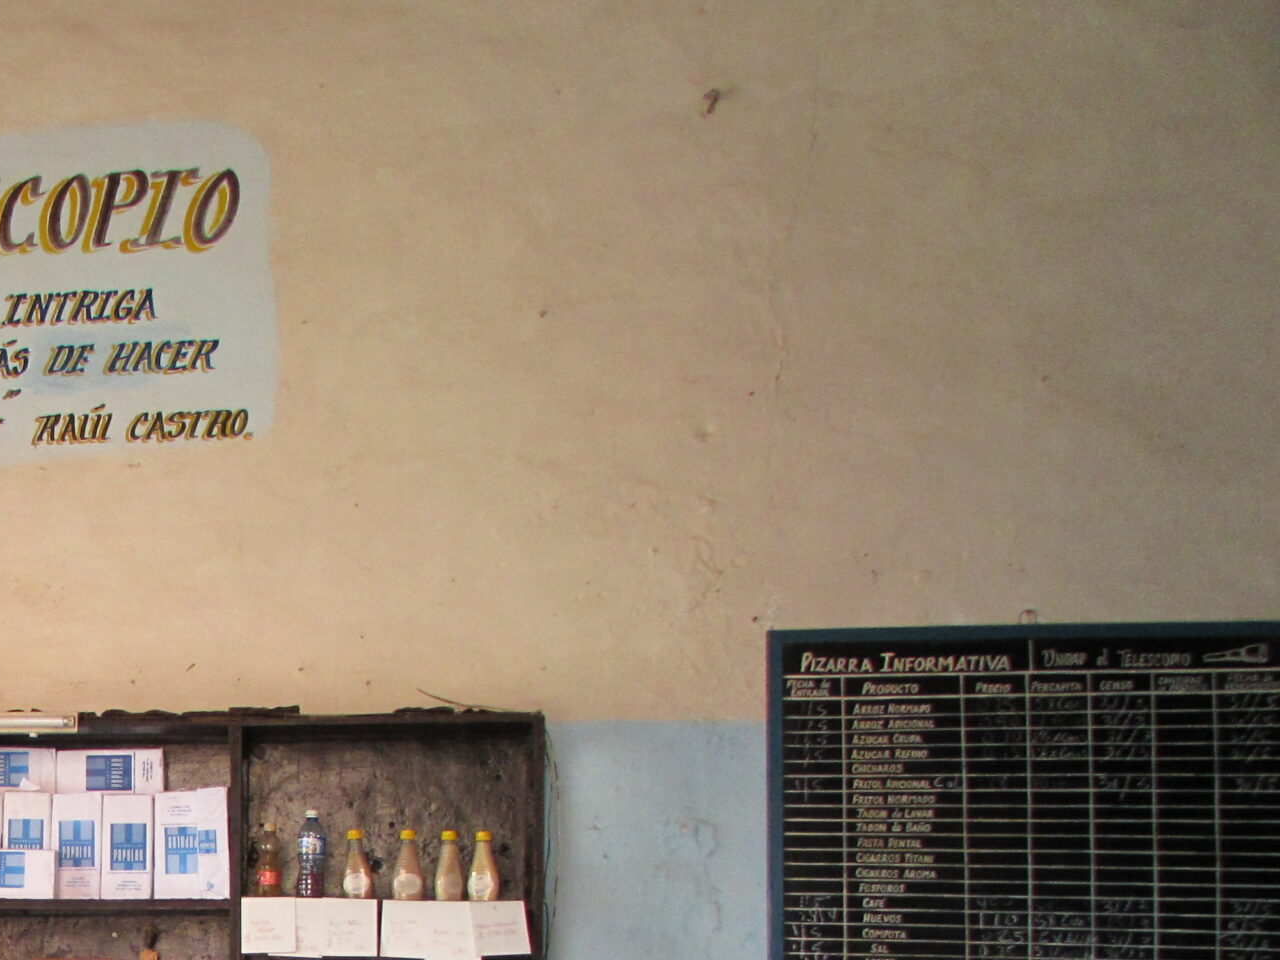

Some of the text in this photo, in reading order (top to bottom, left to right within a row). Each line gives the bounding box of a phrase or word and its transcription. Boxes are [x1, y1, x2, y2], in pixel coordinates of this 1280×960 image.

[44, 343, 95, 377] DE
[103, 338, 220, 376] HACER
[32, 404, 113, 446] RAÚL
[800, 651, 1013, 673] PIZARRA INFORMATIVA
[1116, 649, 1193, 668] TELESCOPIO
[861, 682, 920, 696] PRODUCTO
[975, 682, 1012, 694] PRECIO
[852, 703, 885, 715] ARROZ
[851, 718, 936, 731] ARROZ ADICIONAL
[851, 735, 890, 745] AZUCAR
[851, 749, 891, 760] AZUCAR
[851, 763, 904, 774] CHICHAROS
[904, 808, 936, 819] LAVAR
[856, 838, 885, 849] PASTA
[61, 844, 92, 859] POPULAR
[113, 848, 144, 862] POPULAR
[856, 852, 901, 864] CIGARROS
[855, 868, 937, 880] CIGARROS AROMA
[858, 883, 906, 894] FOSFOROS
[862, 913, 904, 924] HUEVOS
[862, 928, 907, 939] COMPOTA
[870, 943, 890, 954] SAL
